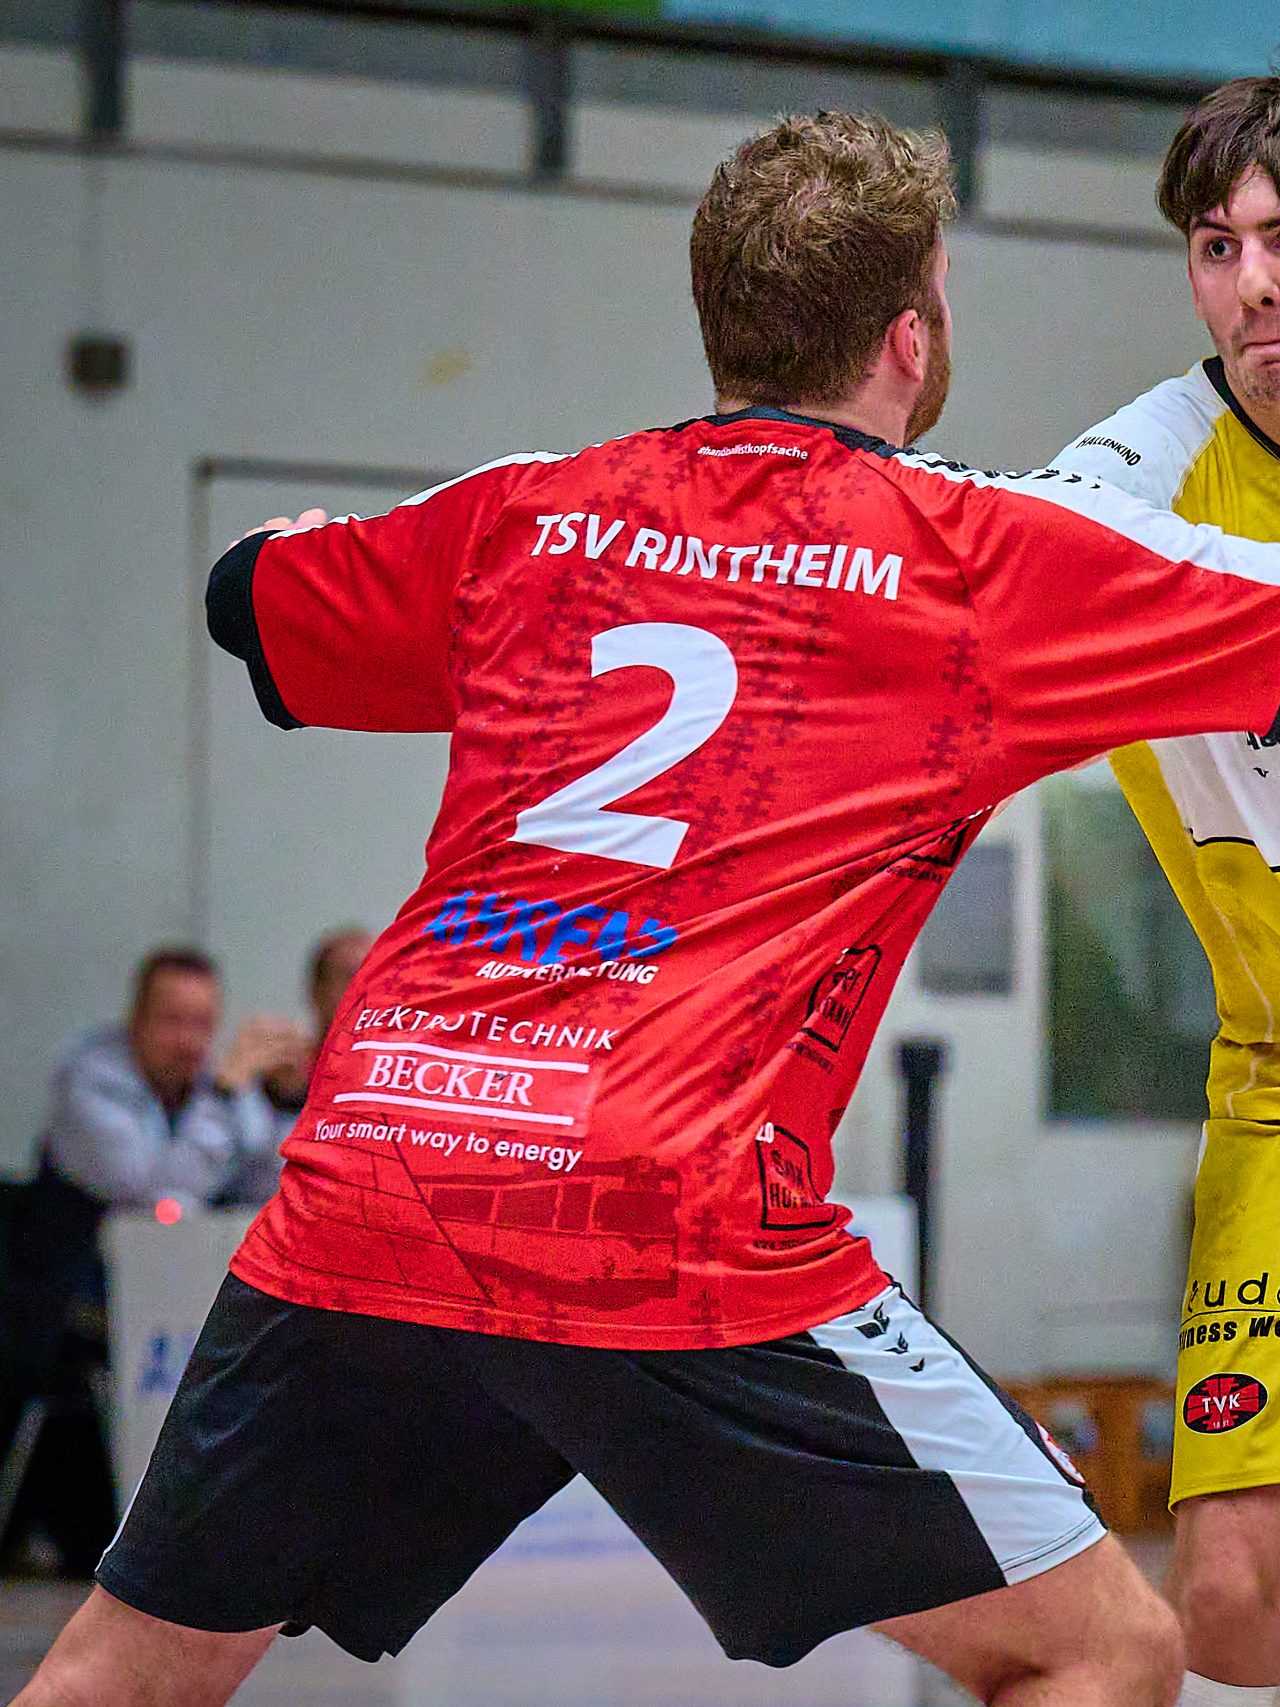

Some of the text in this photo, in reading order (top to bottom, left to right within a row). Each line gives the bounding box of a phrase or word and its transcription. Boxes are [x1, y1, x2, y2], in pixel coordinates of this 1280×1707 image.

[1075, 436, 1142, 466] HALLENKIND
[530, 512, 904, 601] TSV RINTHEIM
[506, 621, 739, 870] 2
[364, 1054, 535, 1107] BECKER
[315, 1119, 583, 1172] Your smart way to energy
[1202, 1393, 1240, 1414] TVK
